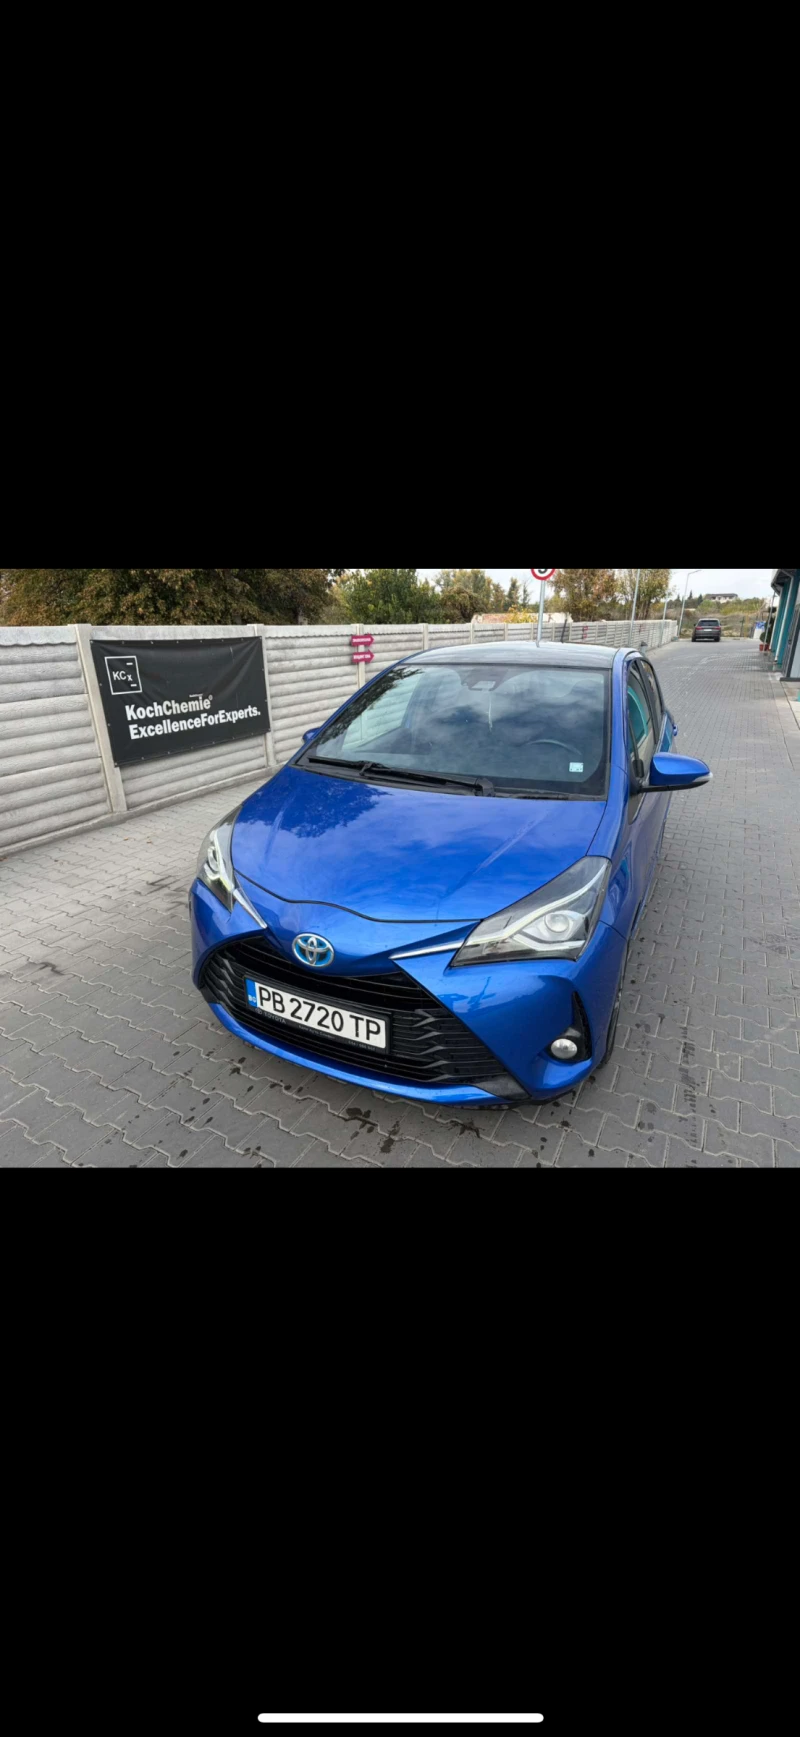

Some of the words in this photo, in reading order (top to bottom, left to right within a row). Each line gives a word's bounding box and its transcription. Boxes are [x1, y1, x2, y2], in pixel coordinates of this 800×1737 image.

[129, 705, 261, 740] ExcellenceForExperts.
[258, 986, 286, 1014] PB
[289, 998, 344, 1032] 2720
[349, 1014, 381, 1041] TP
[264, 1012, 287, 1024] TOYOTA
